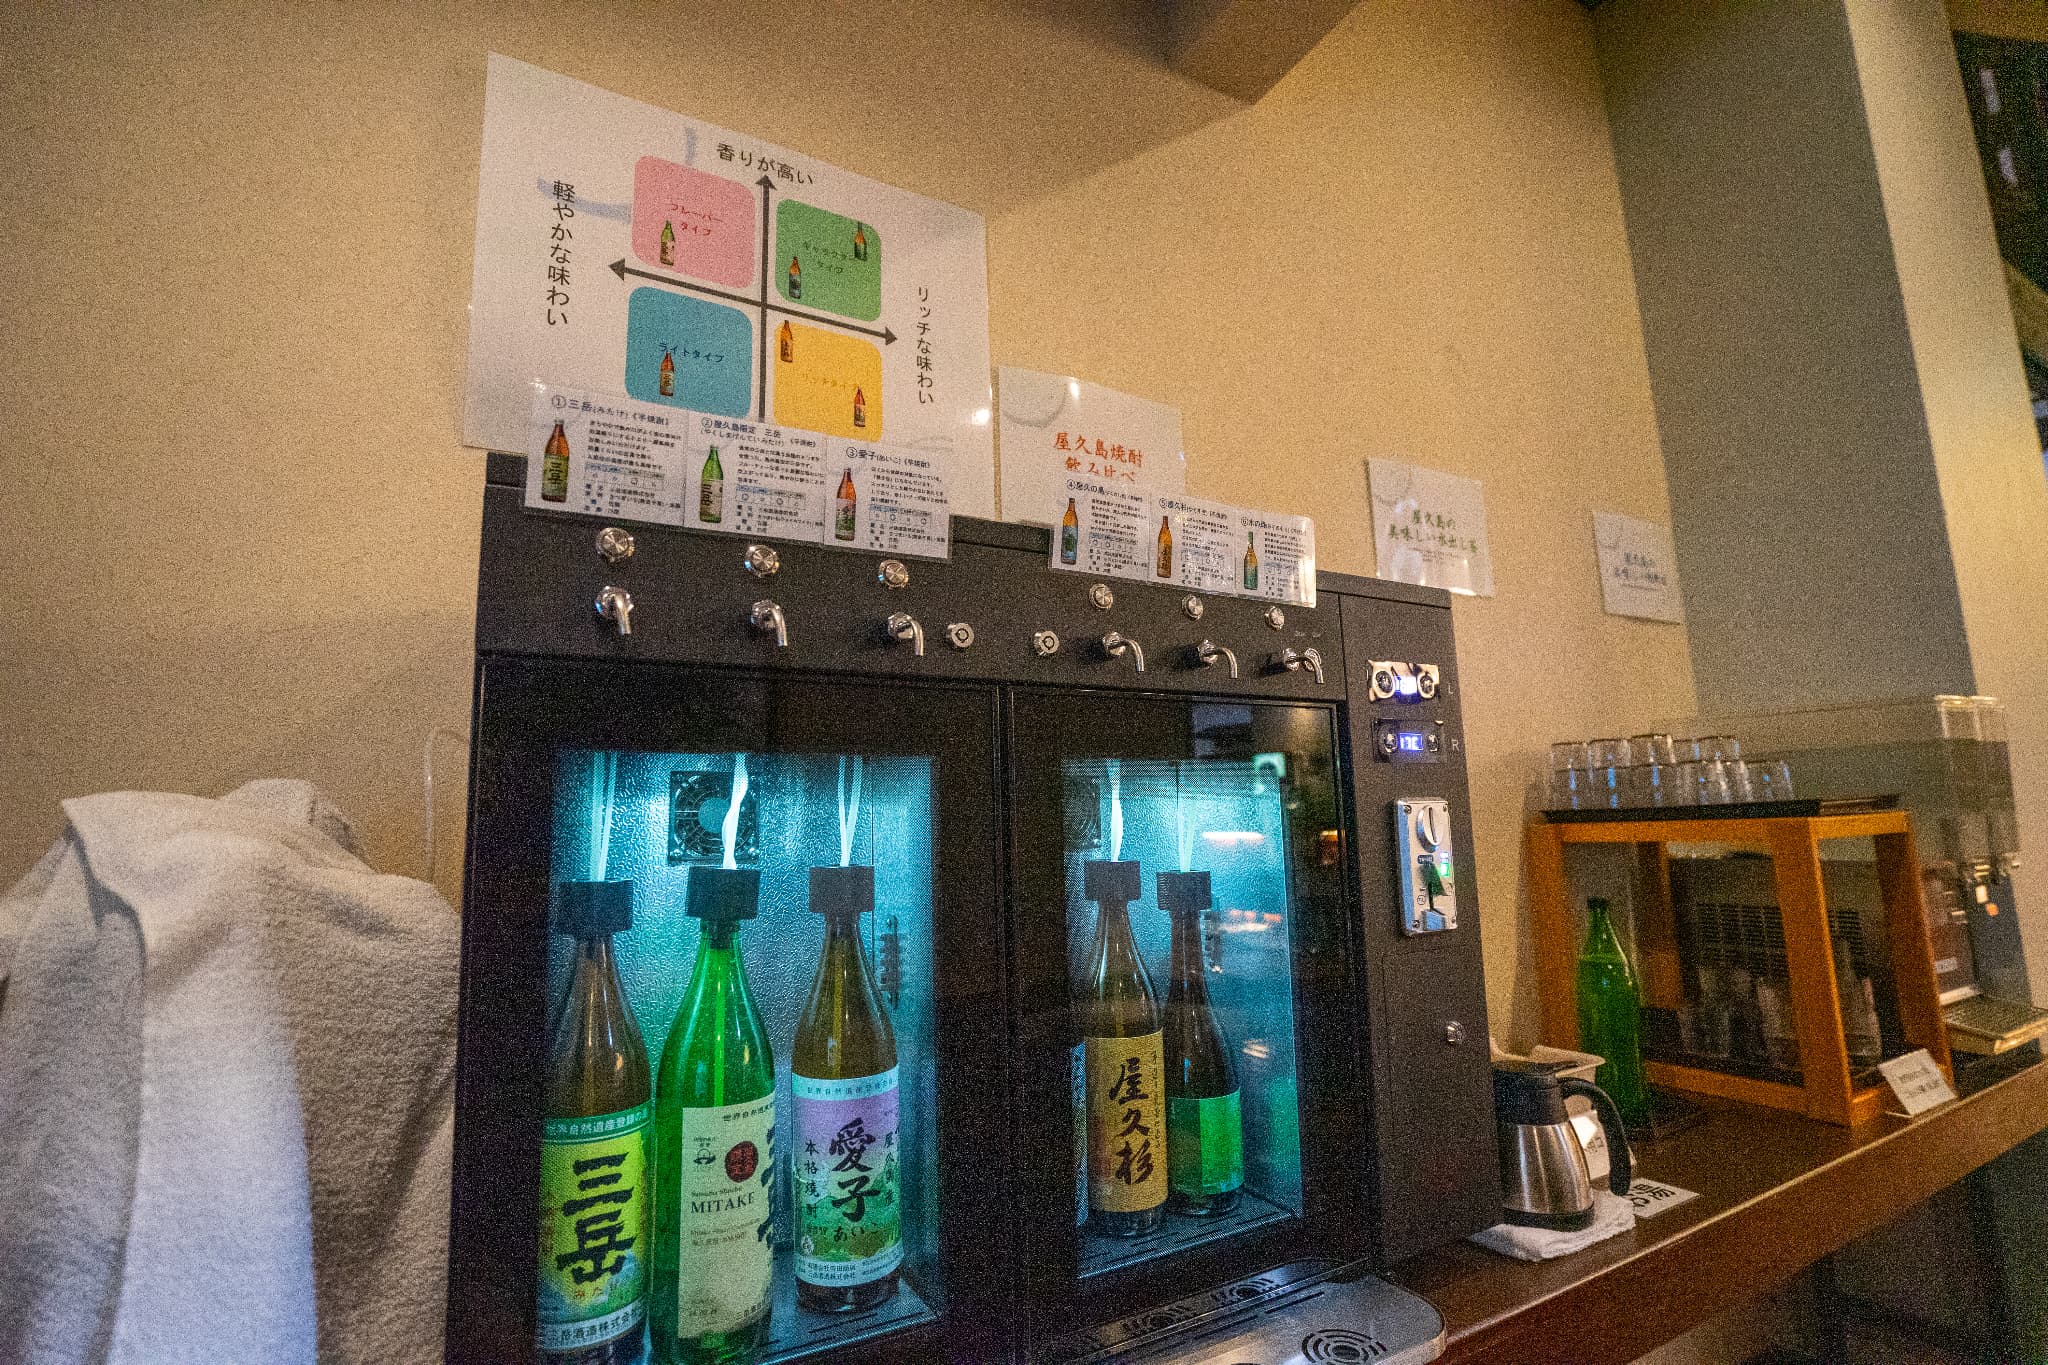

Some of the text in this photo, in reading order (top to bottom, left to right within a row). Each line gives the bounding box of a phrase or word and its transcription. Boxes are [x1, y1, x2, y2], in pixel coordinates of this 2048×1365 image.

[716, 141, 814, 185] 香りが高い
[545, 179, 576, 327] 軽やかな味わい
[917, 286, 935, 405] リッチな味わい
[1053, 432, 1143, 468] 屋久島焼酎
[1065, 456, 1136, 482] 飲み比べ
[1451, 739, 1460, 752] R
[1108, 1056, 1154, 1185] 屋久杉
[690, 1191, 756, 1214] MITAKE
[804, 1139, 820, 1219] 本格焼酎
[828, 1117, 881, 1223] 愛子
[555, 1151, 637, 1285] 三岳
